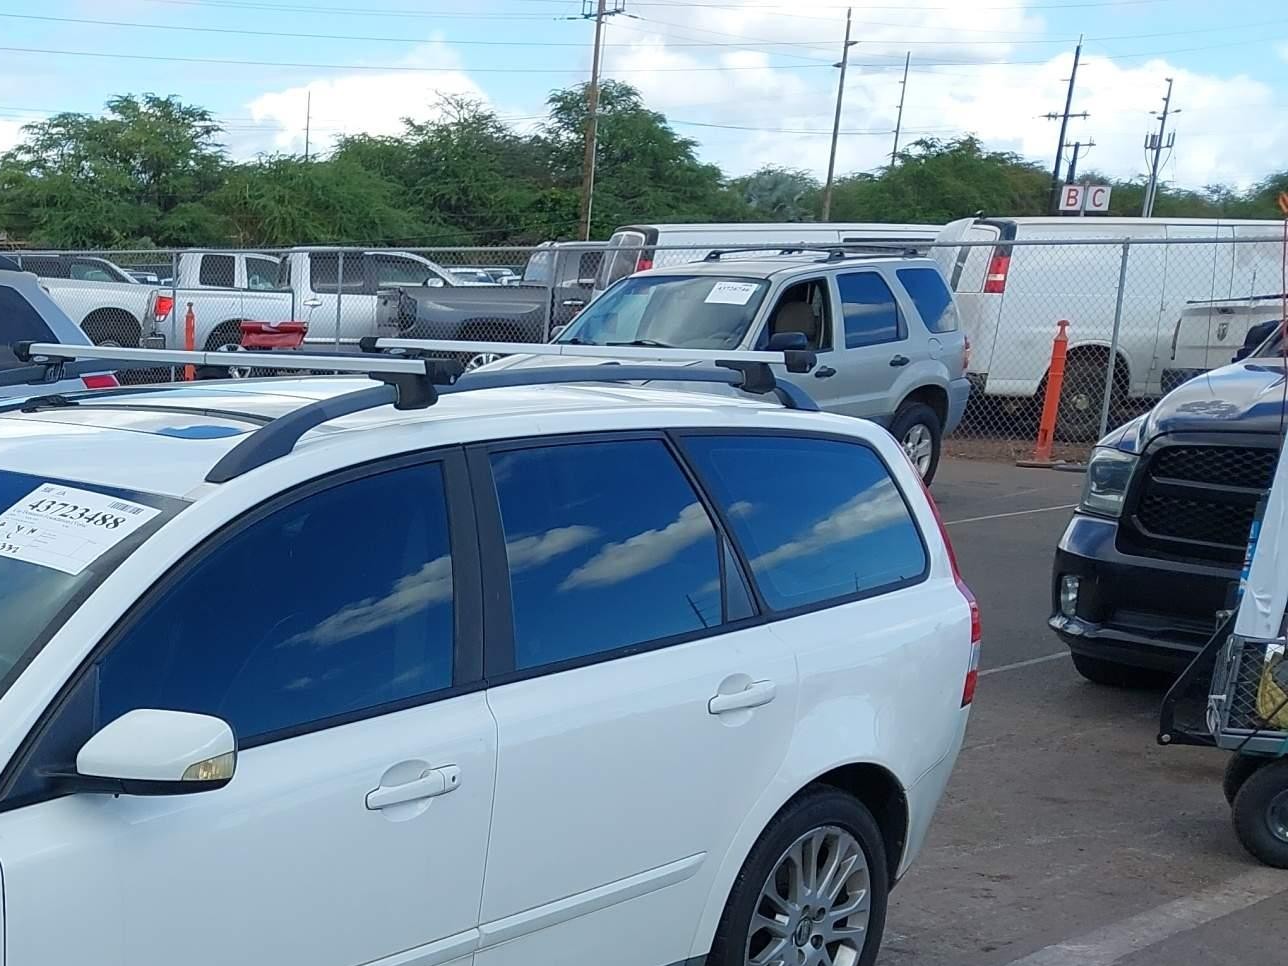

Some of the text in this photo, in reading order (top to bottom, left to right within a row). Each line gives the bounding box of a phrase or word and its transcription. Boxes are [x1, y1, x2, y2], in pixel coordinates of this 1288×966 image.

[1066, 188, 1079, 206] B
[1092, 188, 1105, 208] C
[28, 498, 126, 529] 43723488
